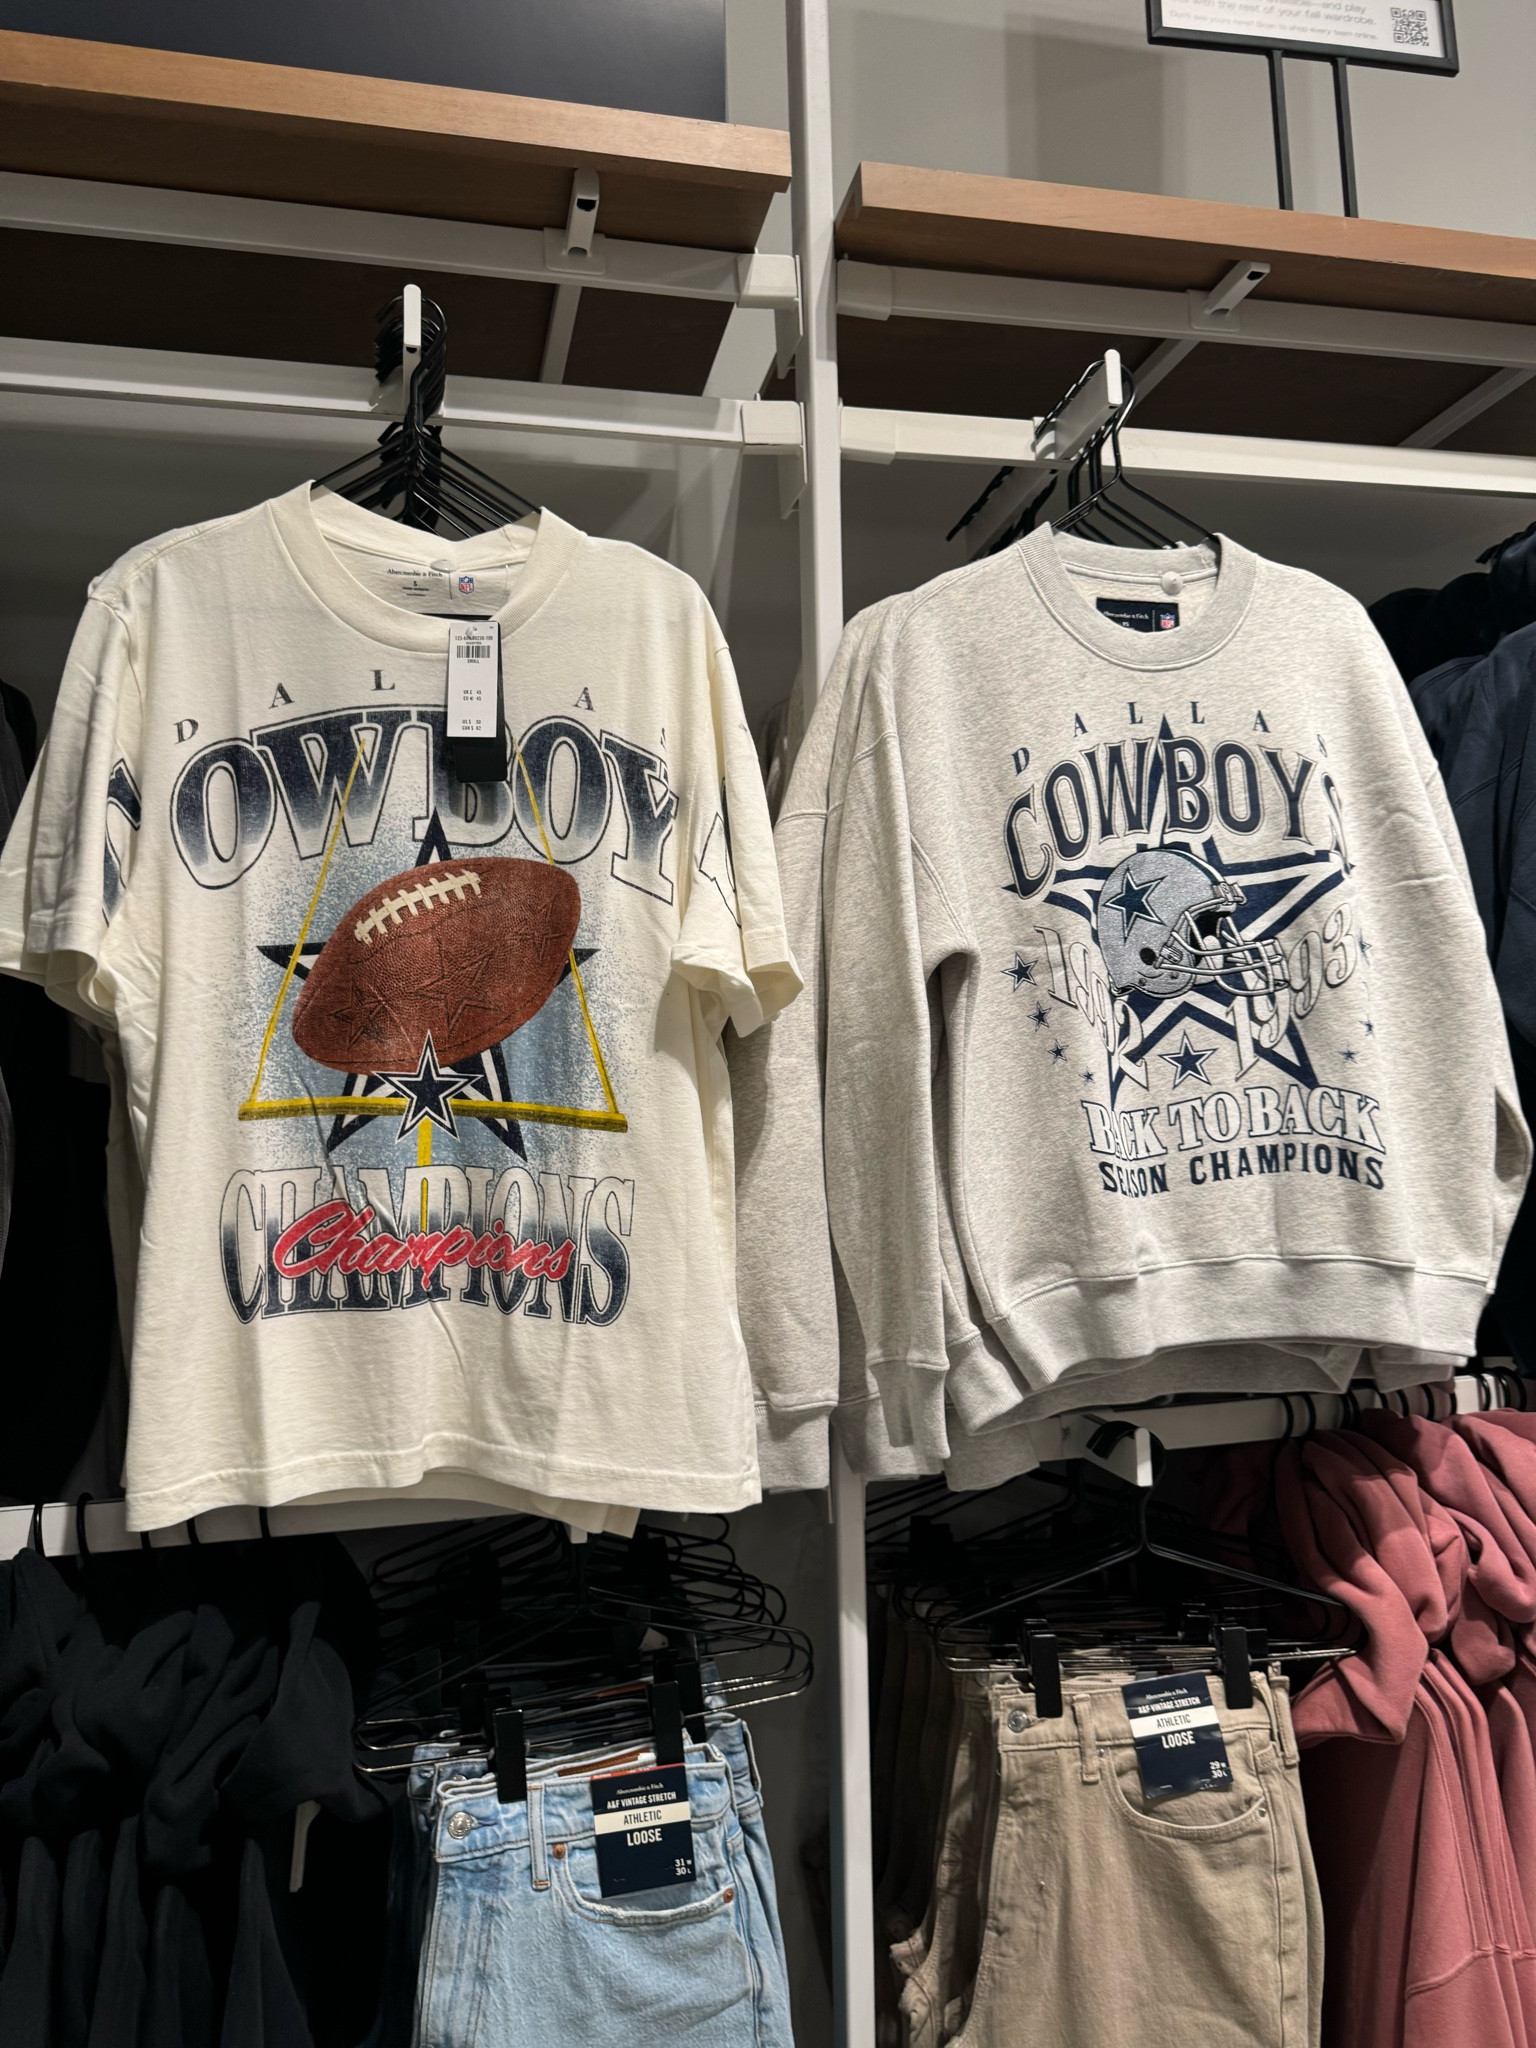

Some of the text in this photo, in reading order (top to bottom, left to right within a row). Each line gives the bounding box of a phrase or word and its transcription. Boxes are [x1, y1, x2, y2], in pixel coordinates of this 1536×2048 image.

[1011, 701, 1328, 776] DALLAS
[1226, 903, 1357, 1081] 1993
[1033, 925, 1149, 1091] 1992
[1081, 1084, 1386, 1161] BACK TO BACK
[1099, 1143, 1384, 1198] SEASON CHAMPIONS
[272, 1197, 577, 1291] Champions
[1175, 1697, 1201, 1708] STRETCH
[1156, 1714, 1192, 1729] ATHLETIC
[1161, 1731, 1196, 1749] LOOSE
[1212, 1770, 1222, 1779] 30
[607, 1792, 677, 1810] A&F VINTAGE STRETCH
[623, 1810, 662, 1825] ATHLETIC
[626, 1828, 663, 1846] LOOSE
[675, 1858, 685, 1868] 31
[676, 1867, 687, 1876] 30
